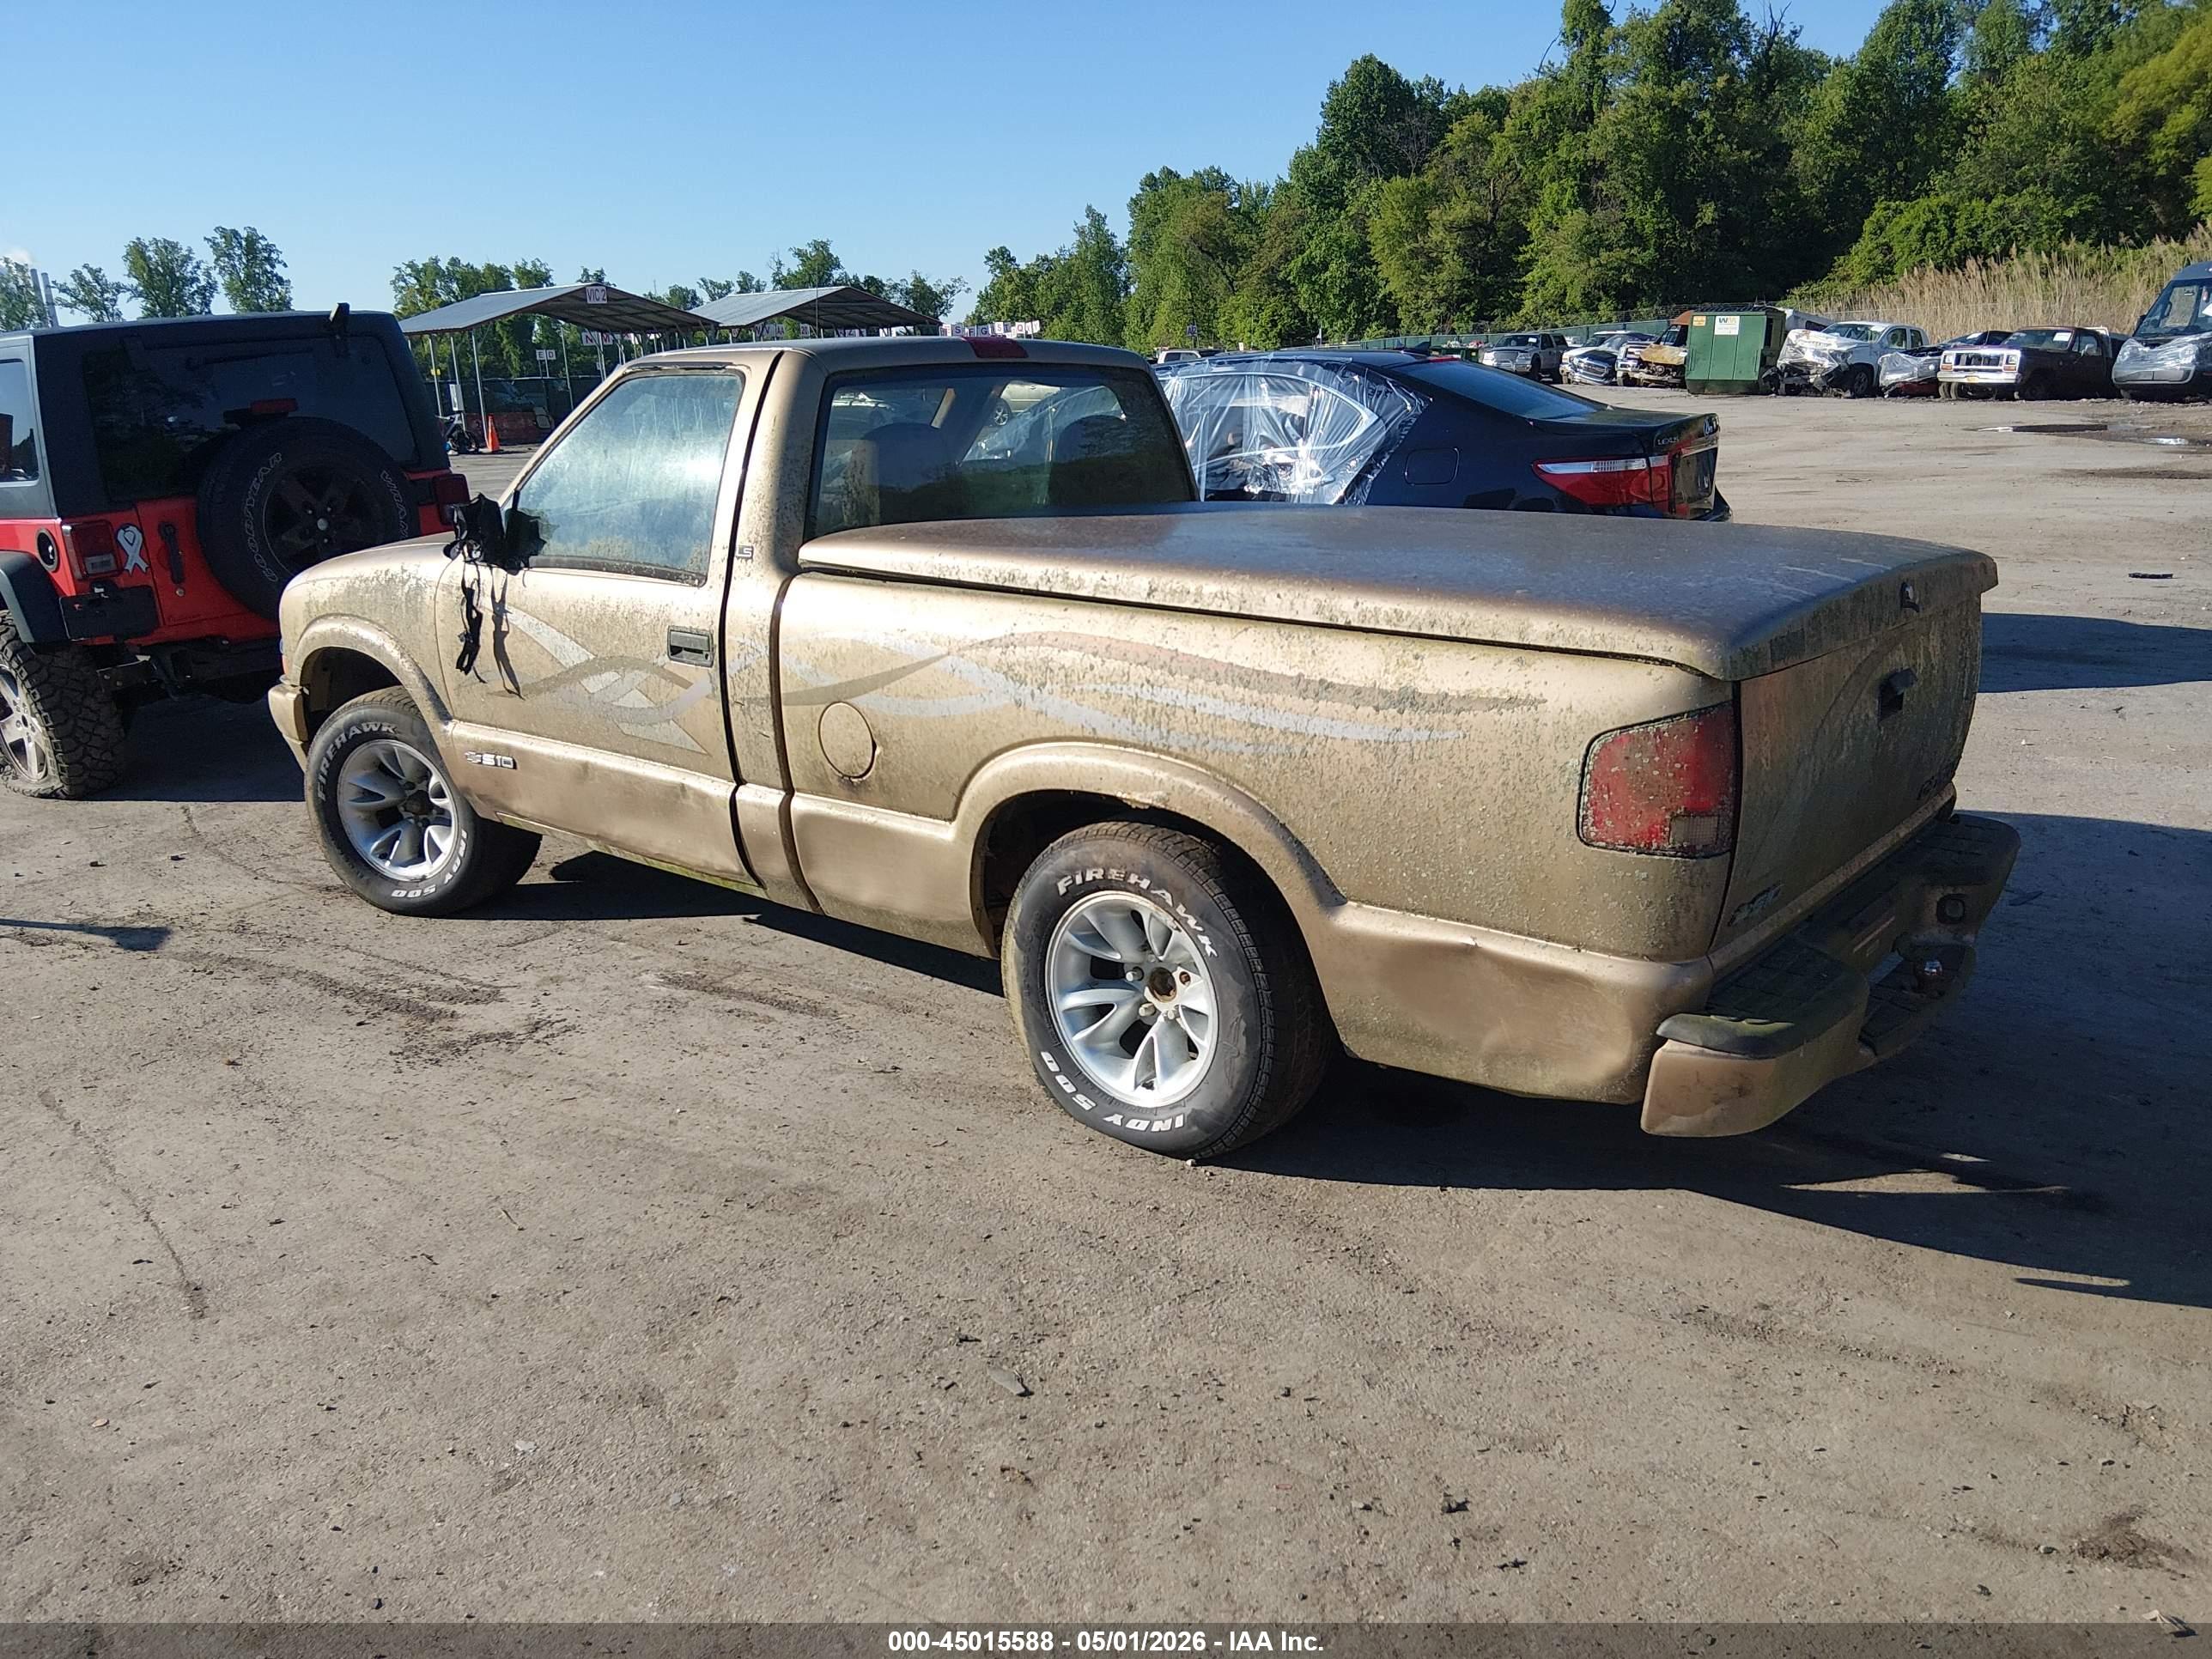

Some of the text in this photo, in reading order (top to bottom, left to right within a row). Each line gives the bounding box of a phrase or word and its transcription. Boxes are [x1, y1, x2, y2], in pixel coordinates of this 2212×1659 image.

[586, 289, 607, 301] VIC 2
[244, 452, 283, 582] GOODYEAR
[736, 546, 753, 558] LS
[317, 721, 399, 802] FIREHAWK
[482, 753, 514, 769] S10
[392, 828, 469, 899] INDY 500
[1057, 867, 1218, 958] FIREHAWK
[1040, 1050, 1185, 1133] INDY 500
